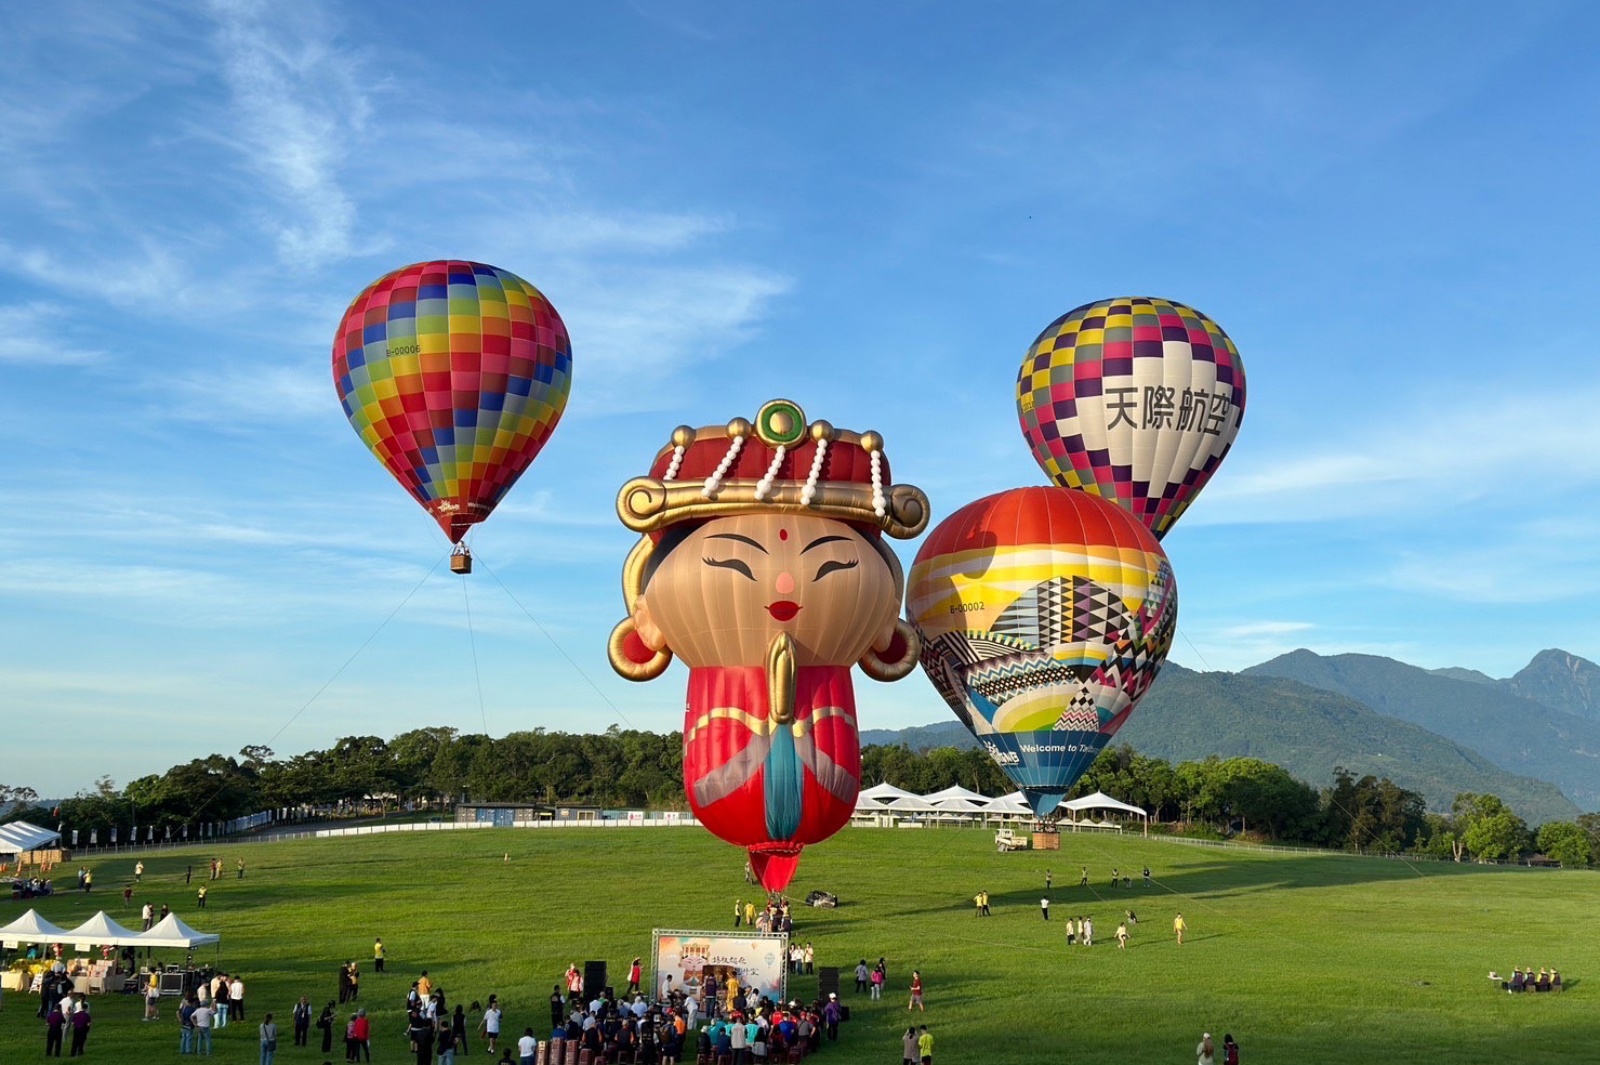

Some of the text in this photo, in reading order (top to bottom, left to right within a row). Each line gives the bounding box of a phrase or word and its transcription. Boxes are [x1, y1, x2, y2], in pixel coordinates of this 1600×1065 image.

[386, 345, 420, 357] B-00006
[1105, 385, 1230, 436] 天際航空
[950, 602, 985, 614] B-00002
[1020, 744, 1066, 753] Welcome
[1068, 744, 1077, 752] to
